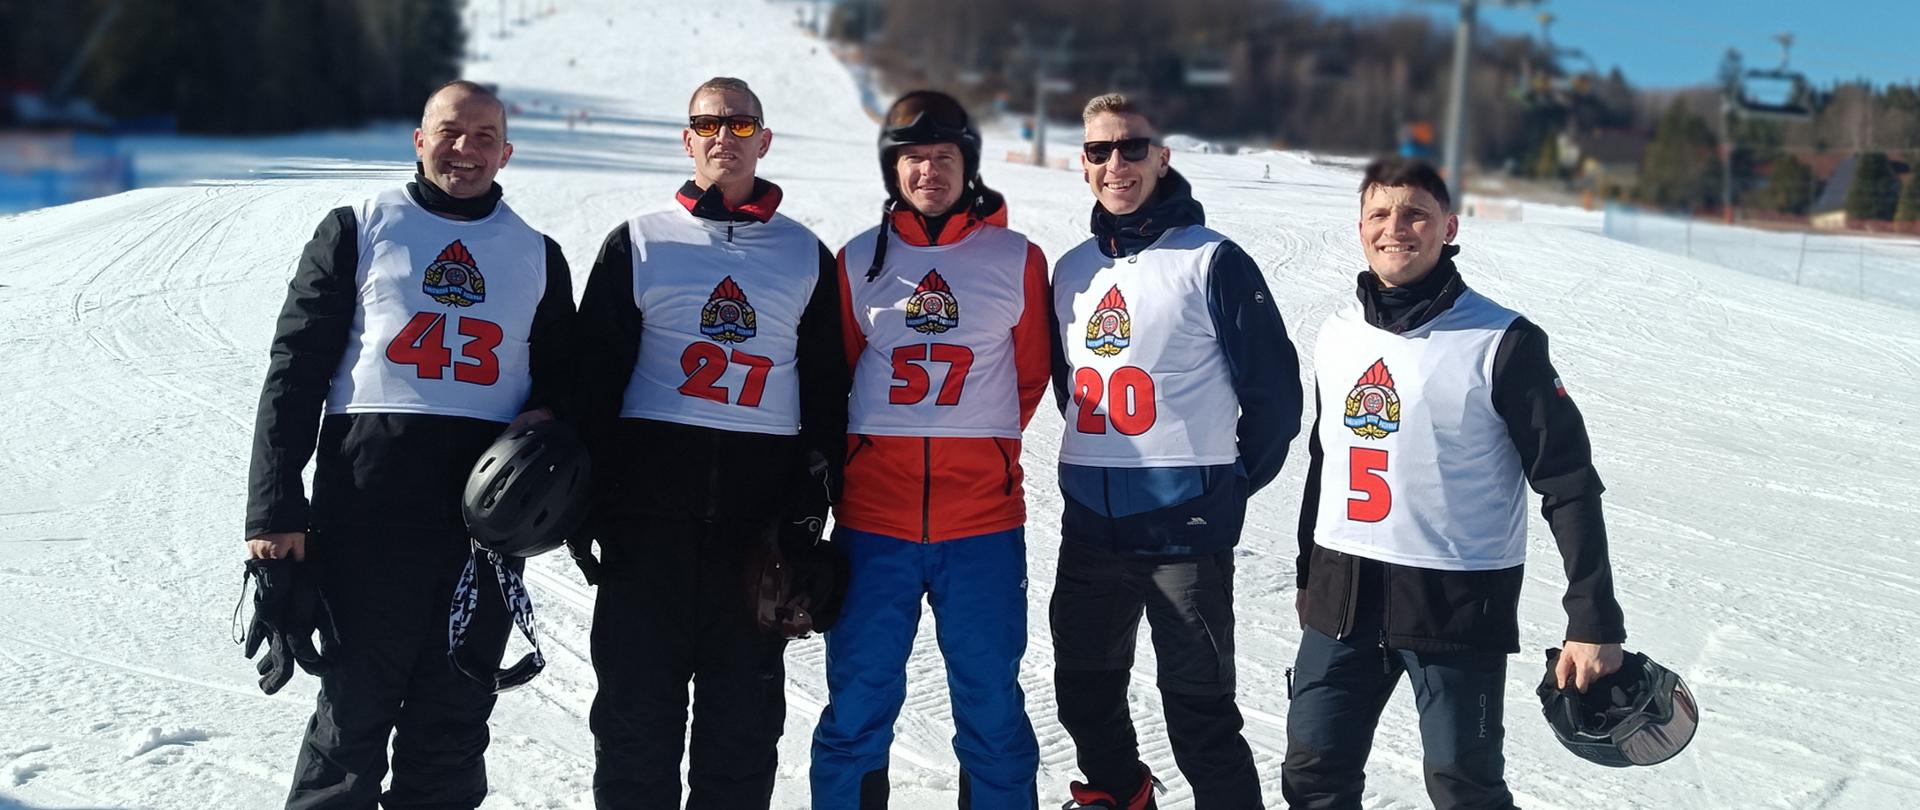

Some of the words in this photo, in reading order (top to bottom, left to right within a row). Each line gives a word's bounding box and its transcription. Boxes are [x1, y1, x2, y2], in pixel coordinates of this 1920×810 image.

[386, 311, 503, 386] 43
[677, 341, 774, 407] 27
[889, 343, 974, 406] 57
[1074, 366, 1157, 436] 20
[1347, 446, 1392, 523] 5
[1479, 694, 1487, 738] MILO
